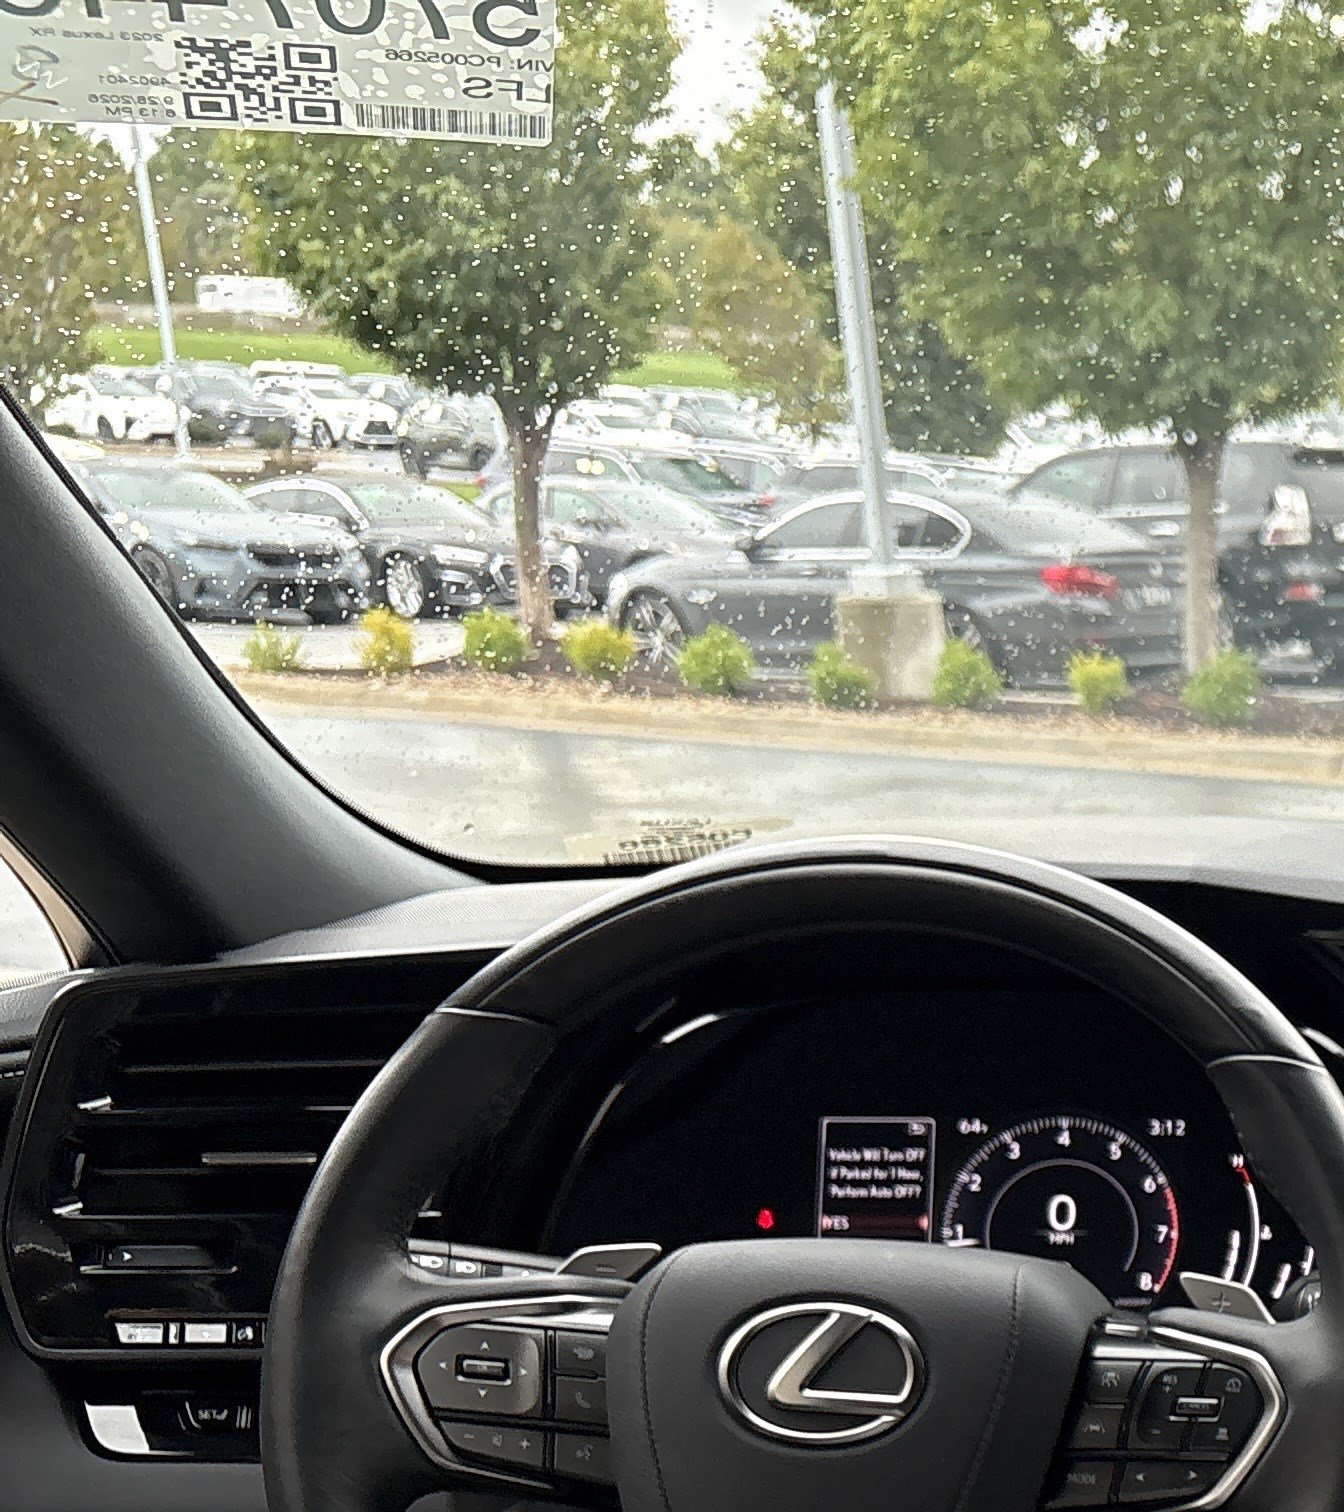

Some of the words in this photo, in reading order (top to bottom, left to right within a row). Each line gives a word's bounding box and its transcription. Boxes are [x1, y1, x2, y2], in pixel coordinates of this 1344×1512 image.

[1148, 1118, 1186, 1136] 3:12
[969, 1172, 982, 1192] 2
[1143, 1175, 1157, 1193] 6
[1046, 1193, 1077, 1232] 0
[1155, 1224, 1169, 1243] 7
